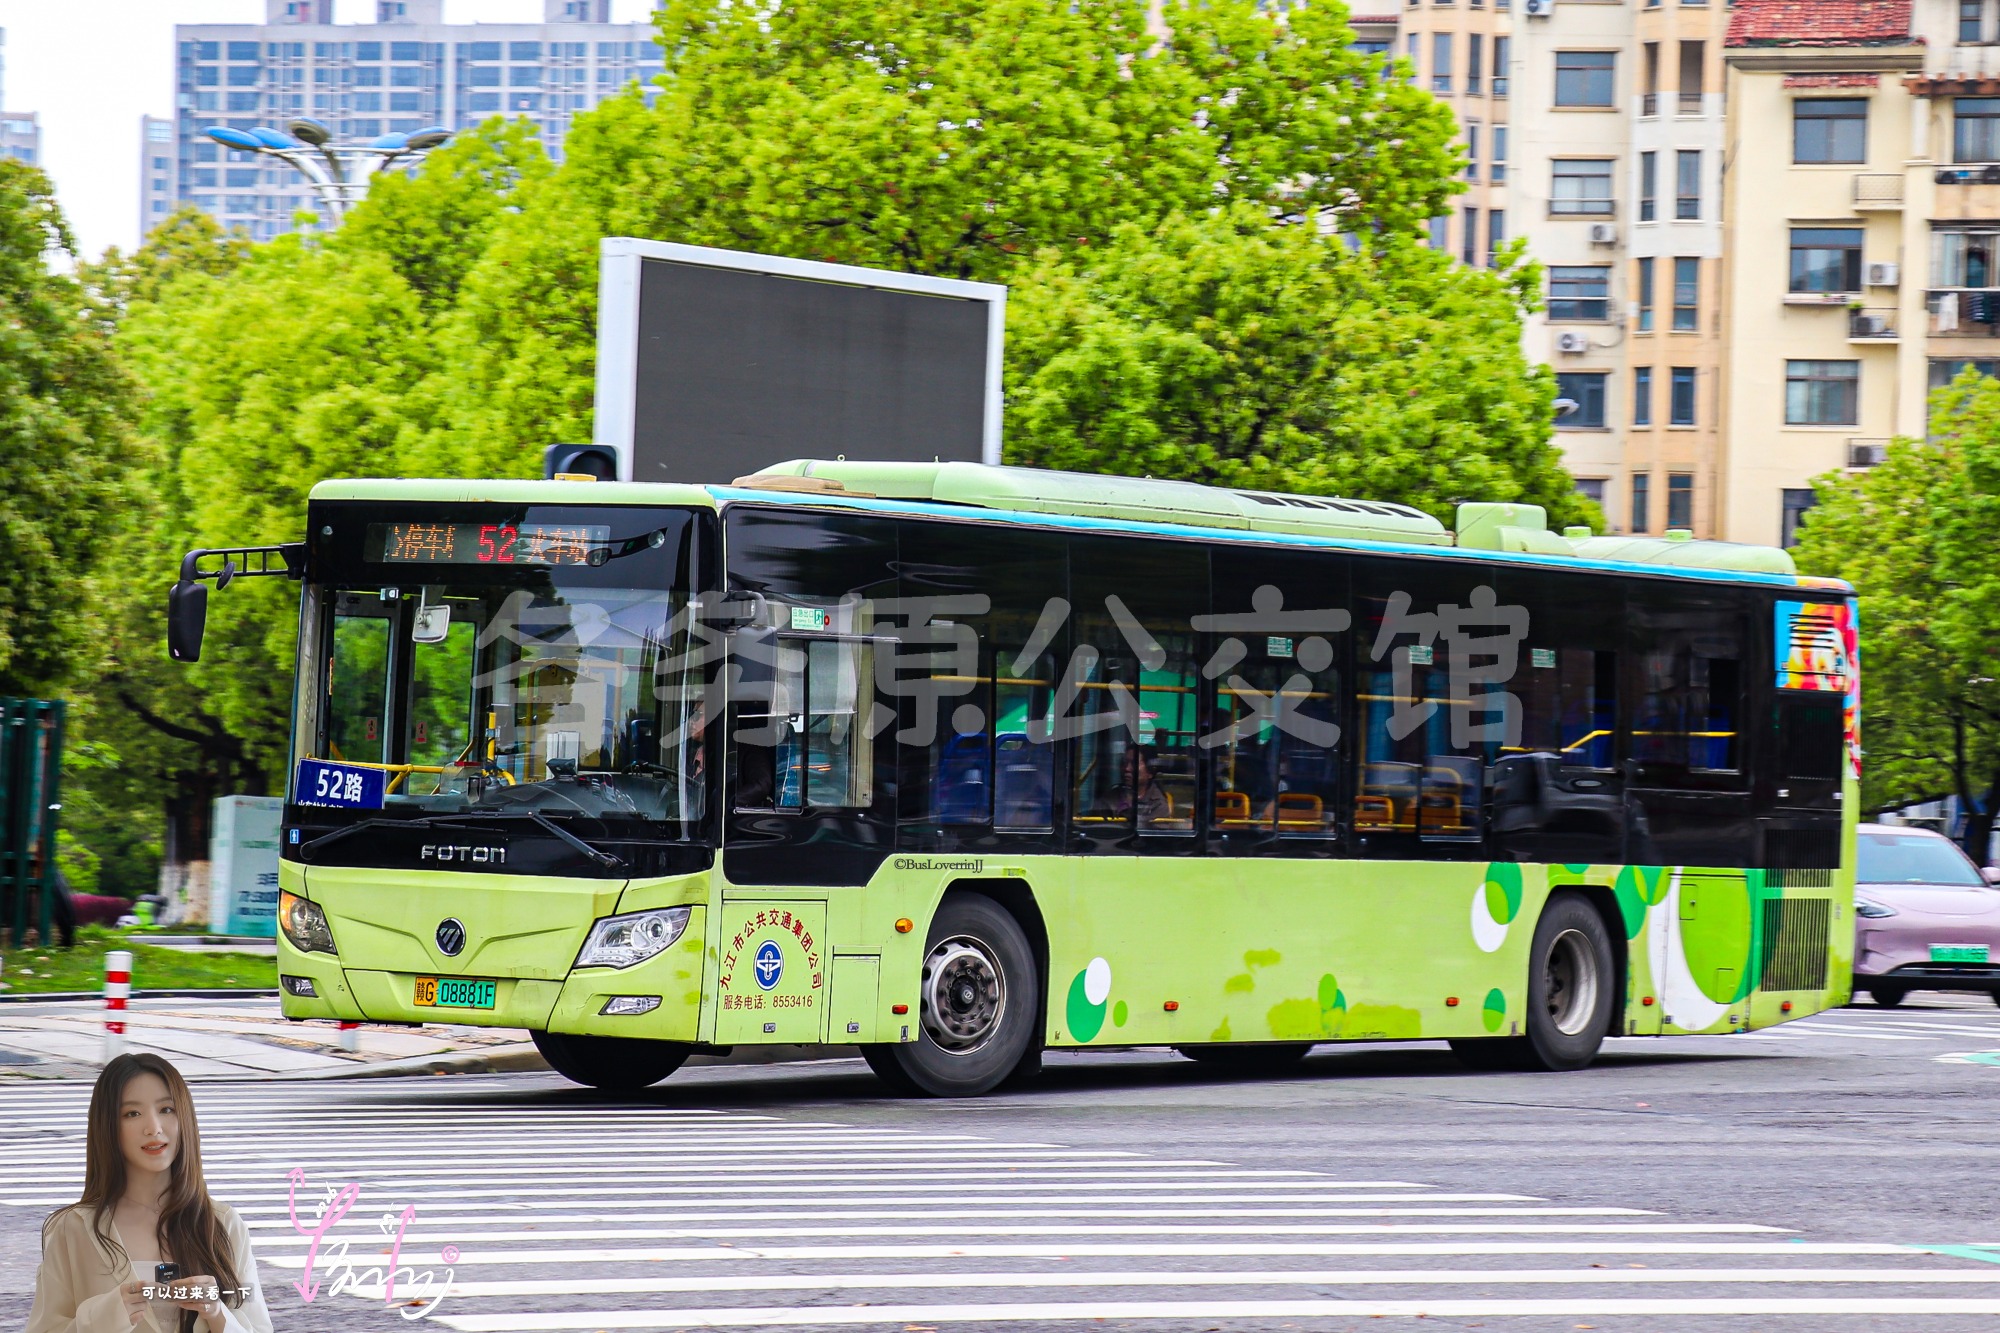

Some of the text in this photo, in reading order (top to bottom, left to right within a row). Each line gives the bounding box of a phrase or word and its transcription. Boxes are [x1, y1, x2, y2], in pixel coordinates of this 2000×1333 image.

[478, 526, 518, 562] 52
[316, 768, 363, 803] 52路
[421, 844, 506, 863] FOTON
[720, 908, 823, 990] 九江市公共交通集团公司
